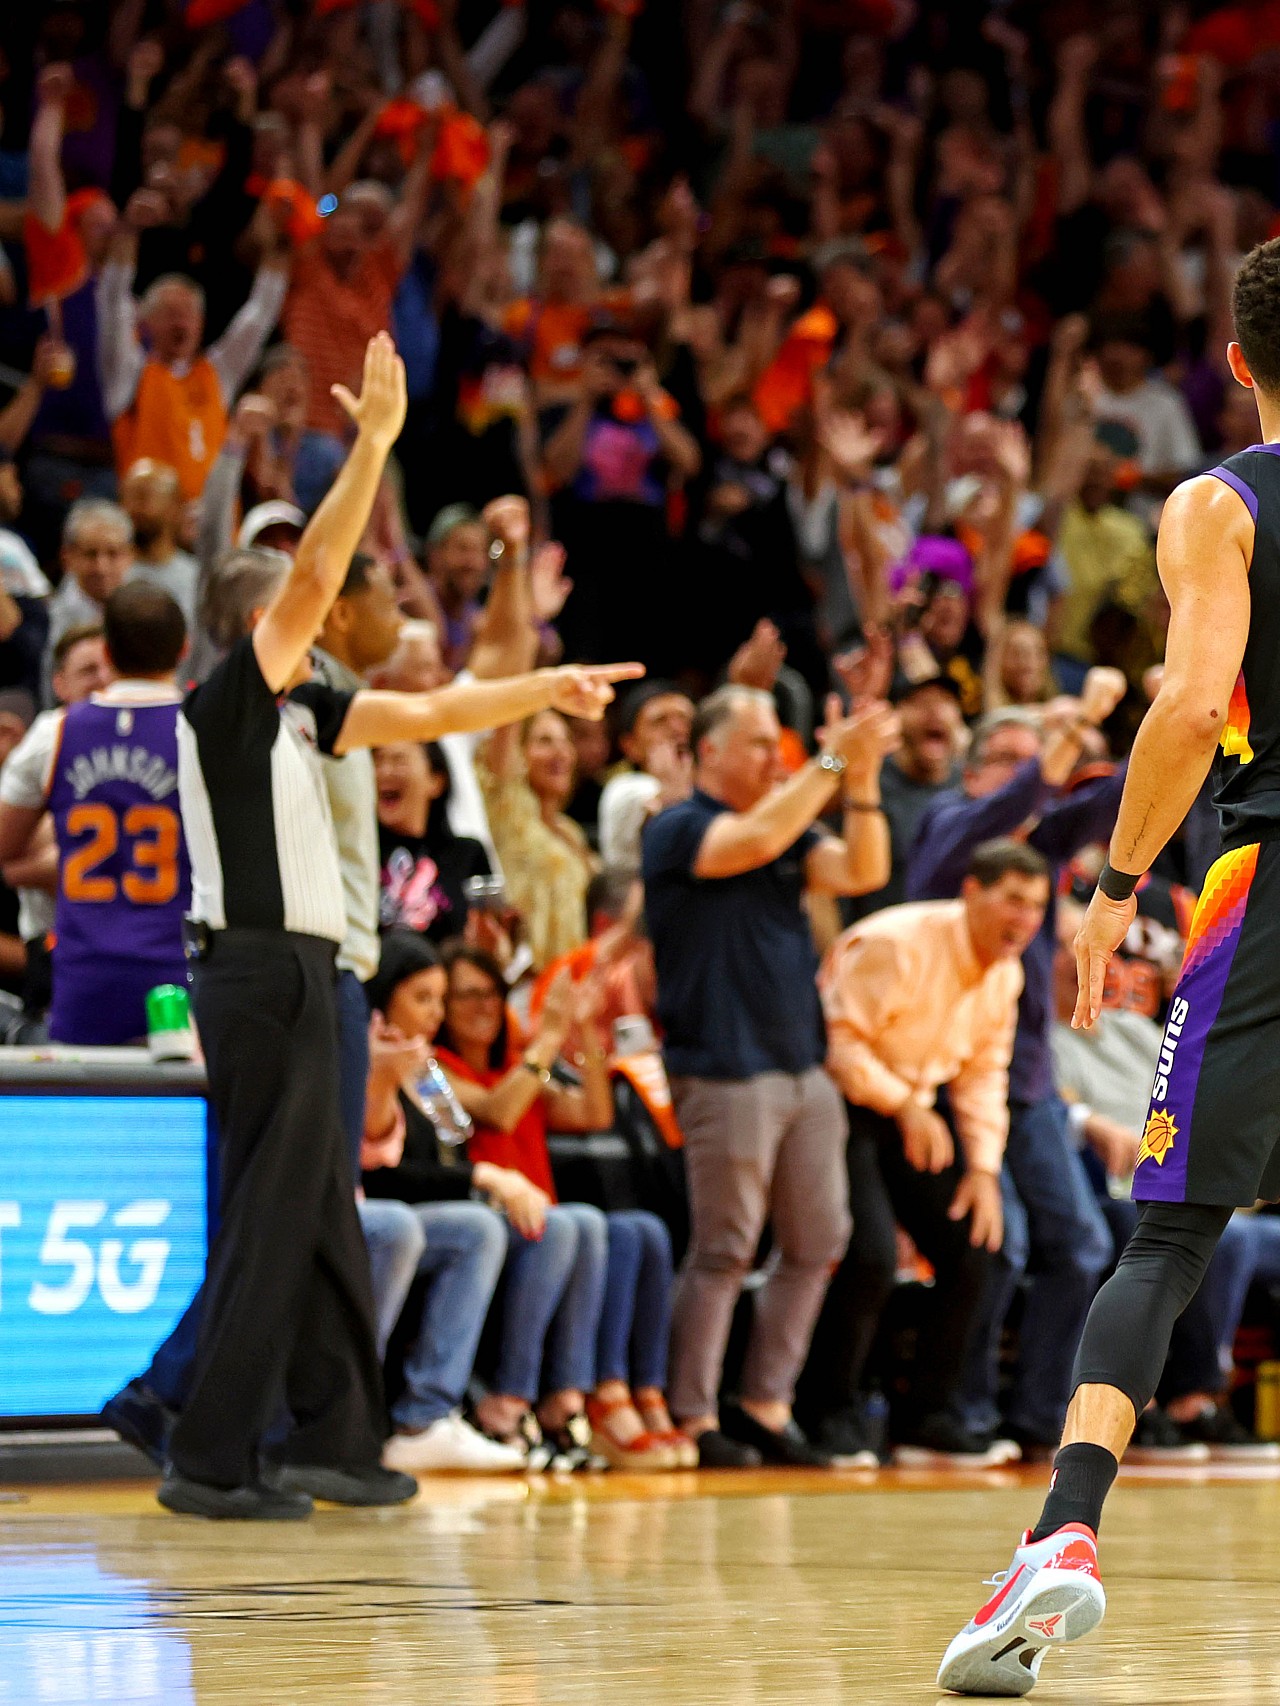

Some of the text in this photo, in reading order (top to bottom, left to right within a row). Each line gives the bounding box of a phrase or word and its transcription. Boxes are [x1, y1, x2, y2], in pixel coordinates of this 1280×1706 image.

[65, 743, 178, 800] JOHNSON
[63, 803, 180, 904] 23
[28, 1199, 173, 1315] 5G
